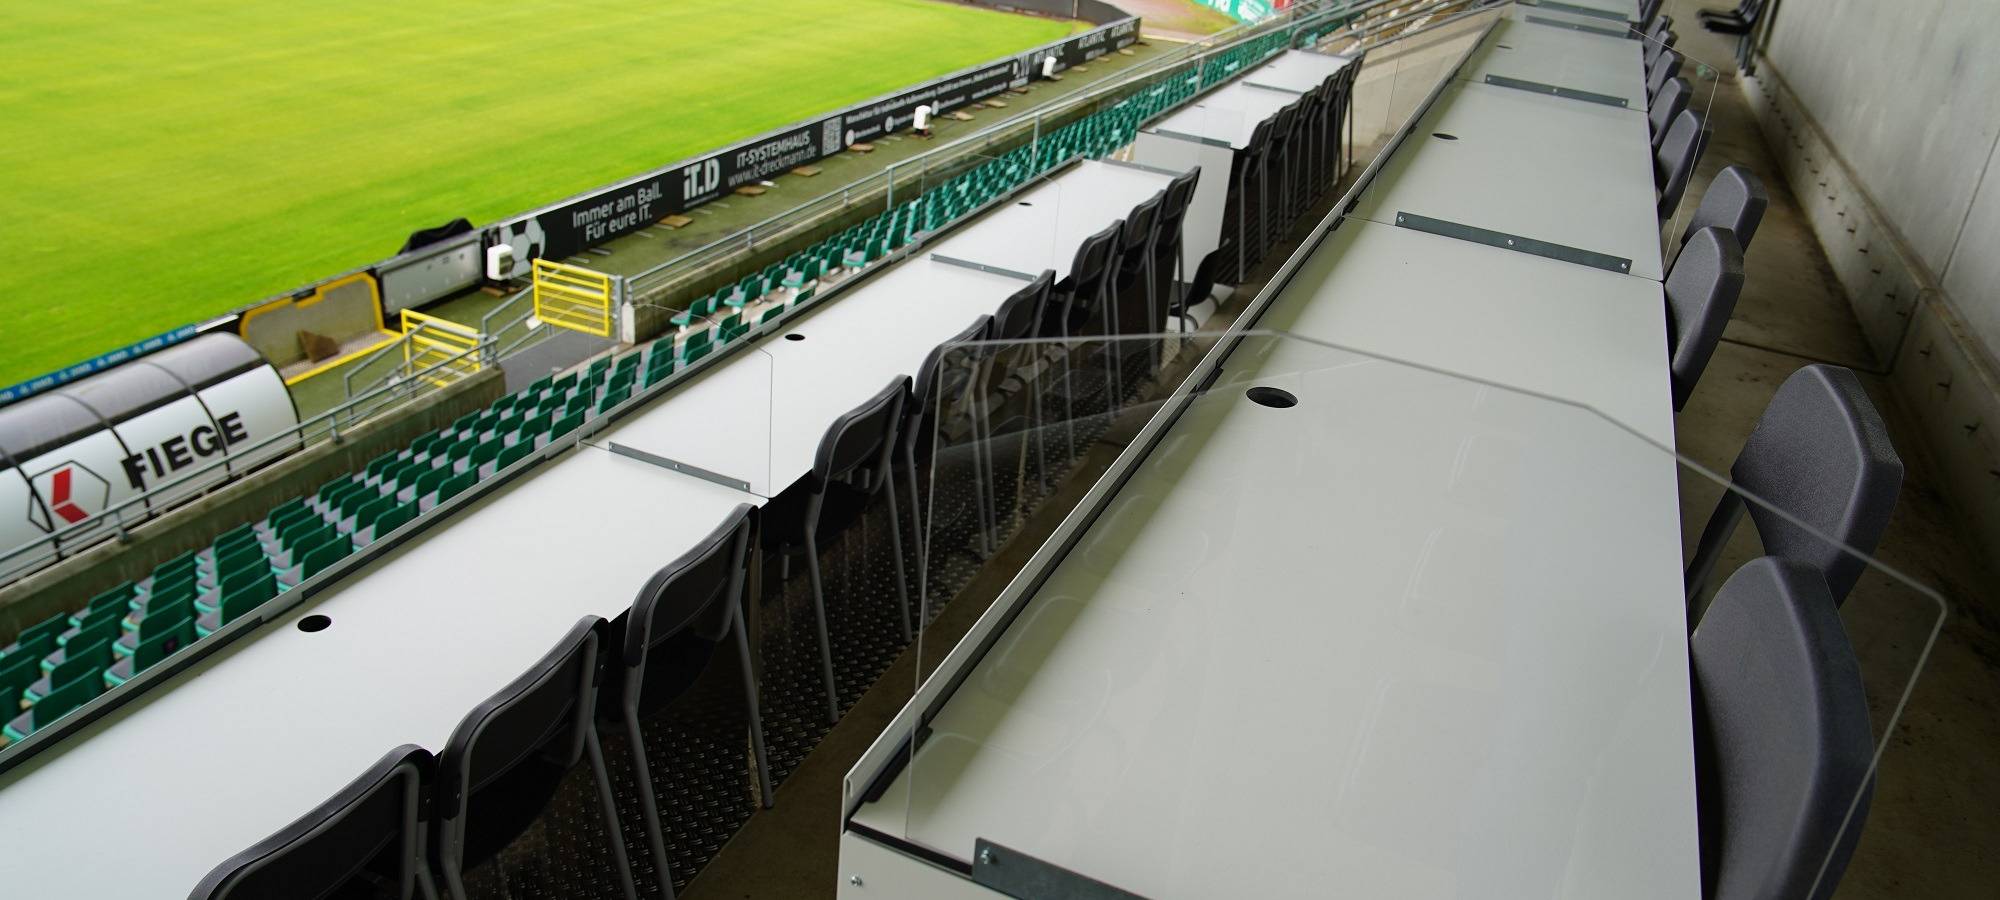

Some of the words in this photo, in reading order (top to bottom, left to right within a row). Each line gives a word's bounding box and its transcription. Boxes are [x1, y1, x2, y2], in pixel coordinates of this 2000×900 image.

[736, 130, 811, 169] IT-SYSTEMHAUS
[572, 201, 613, 228] Immer
[616, 194, 635, 212] am
[637, 181, 662, 206] Ball.
[585, 221, 606, 242] Für
[608, 212, 636, 234] eure
[638, 205, 652, 222] IT.
[120, 411, 249, 489] FIEGE
